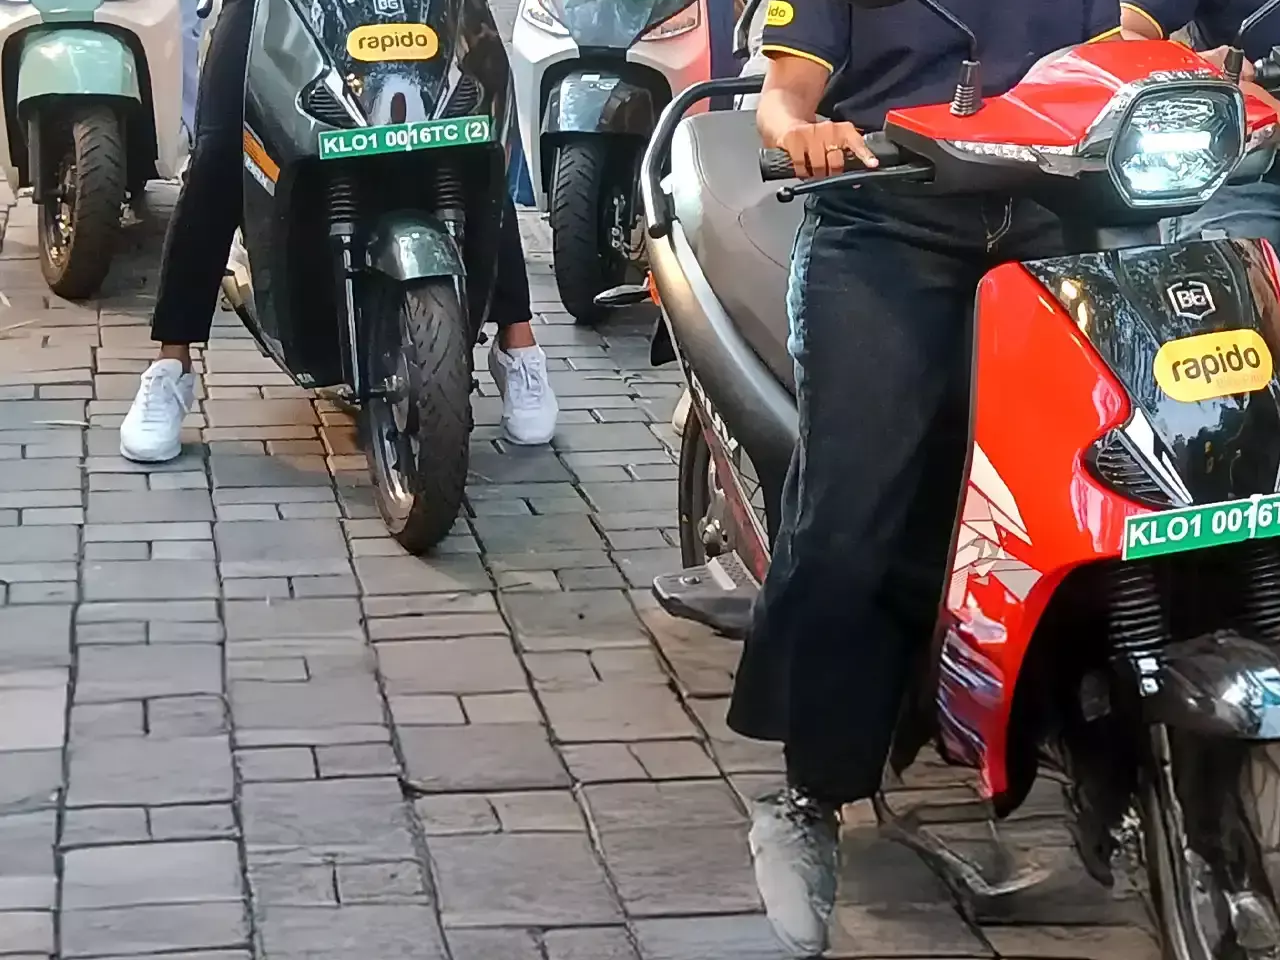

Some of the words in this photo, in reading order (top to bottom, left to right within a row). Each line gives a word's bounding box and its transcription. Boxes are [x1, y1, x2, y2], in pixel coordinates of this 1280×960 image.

[768, 6, 786, 18] ido
[358, 31, 428, 52] rapido
[385, 123, 459, 147] 0016TC
[464, 120, 489, 143] (2)
[1171, 343, 1261, 384] rapido
